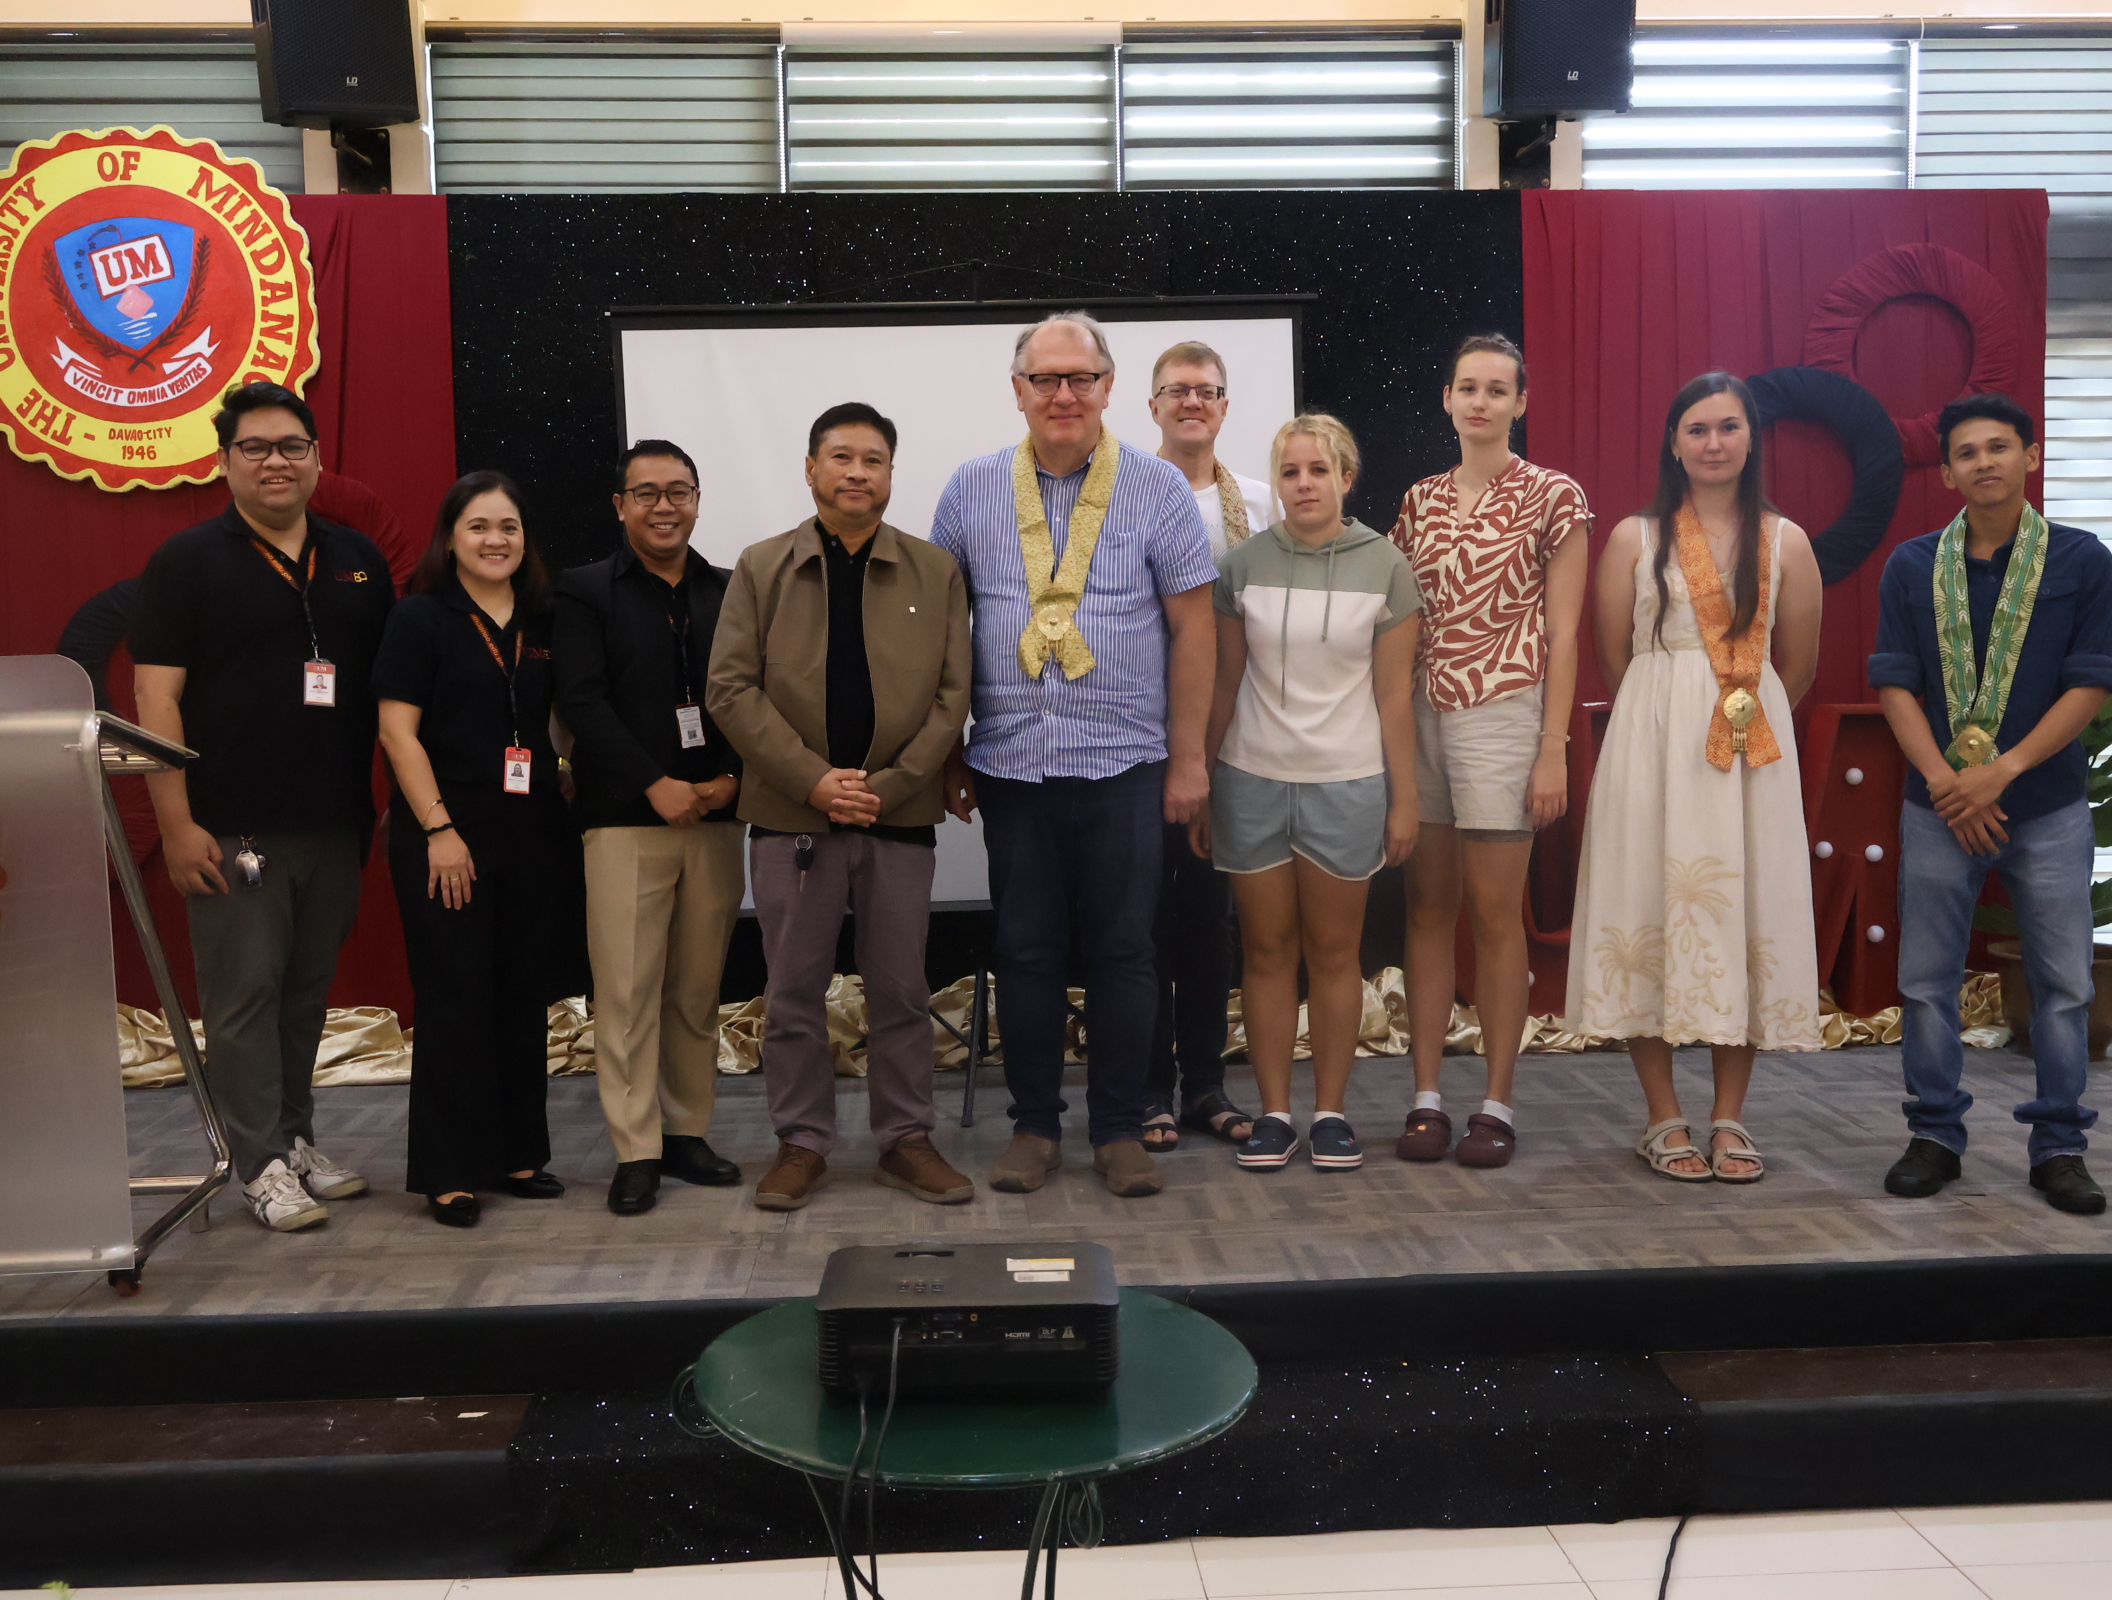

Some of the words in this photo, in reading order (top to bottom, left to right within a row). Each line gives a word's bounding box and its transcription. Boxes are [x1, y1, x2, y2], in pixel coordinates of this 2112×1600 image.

[99, 243, 166, 287] UM
[15, 388, 77, 447] THE
[96, 150, 141, 182] OF
[73, 372, 124, 403] VINCIT
[127, 389, 169, 405] OMNIA
[167, 362, 208, 396] VERITAS
[121, 445, 157, 460] 1946
